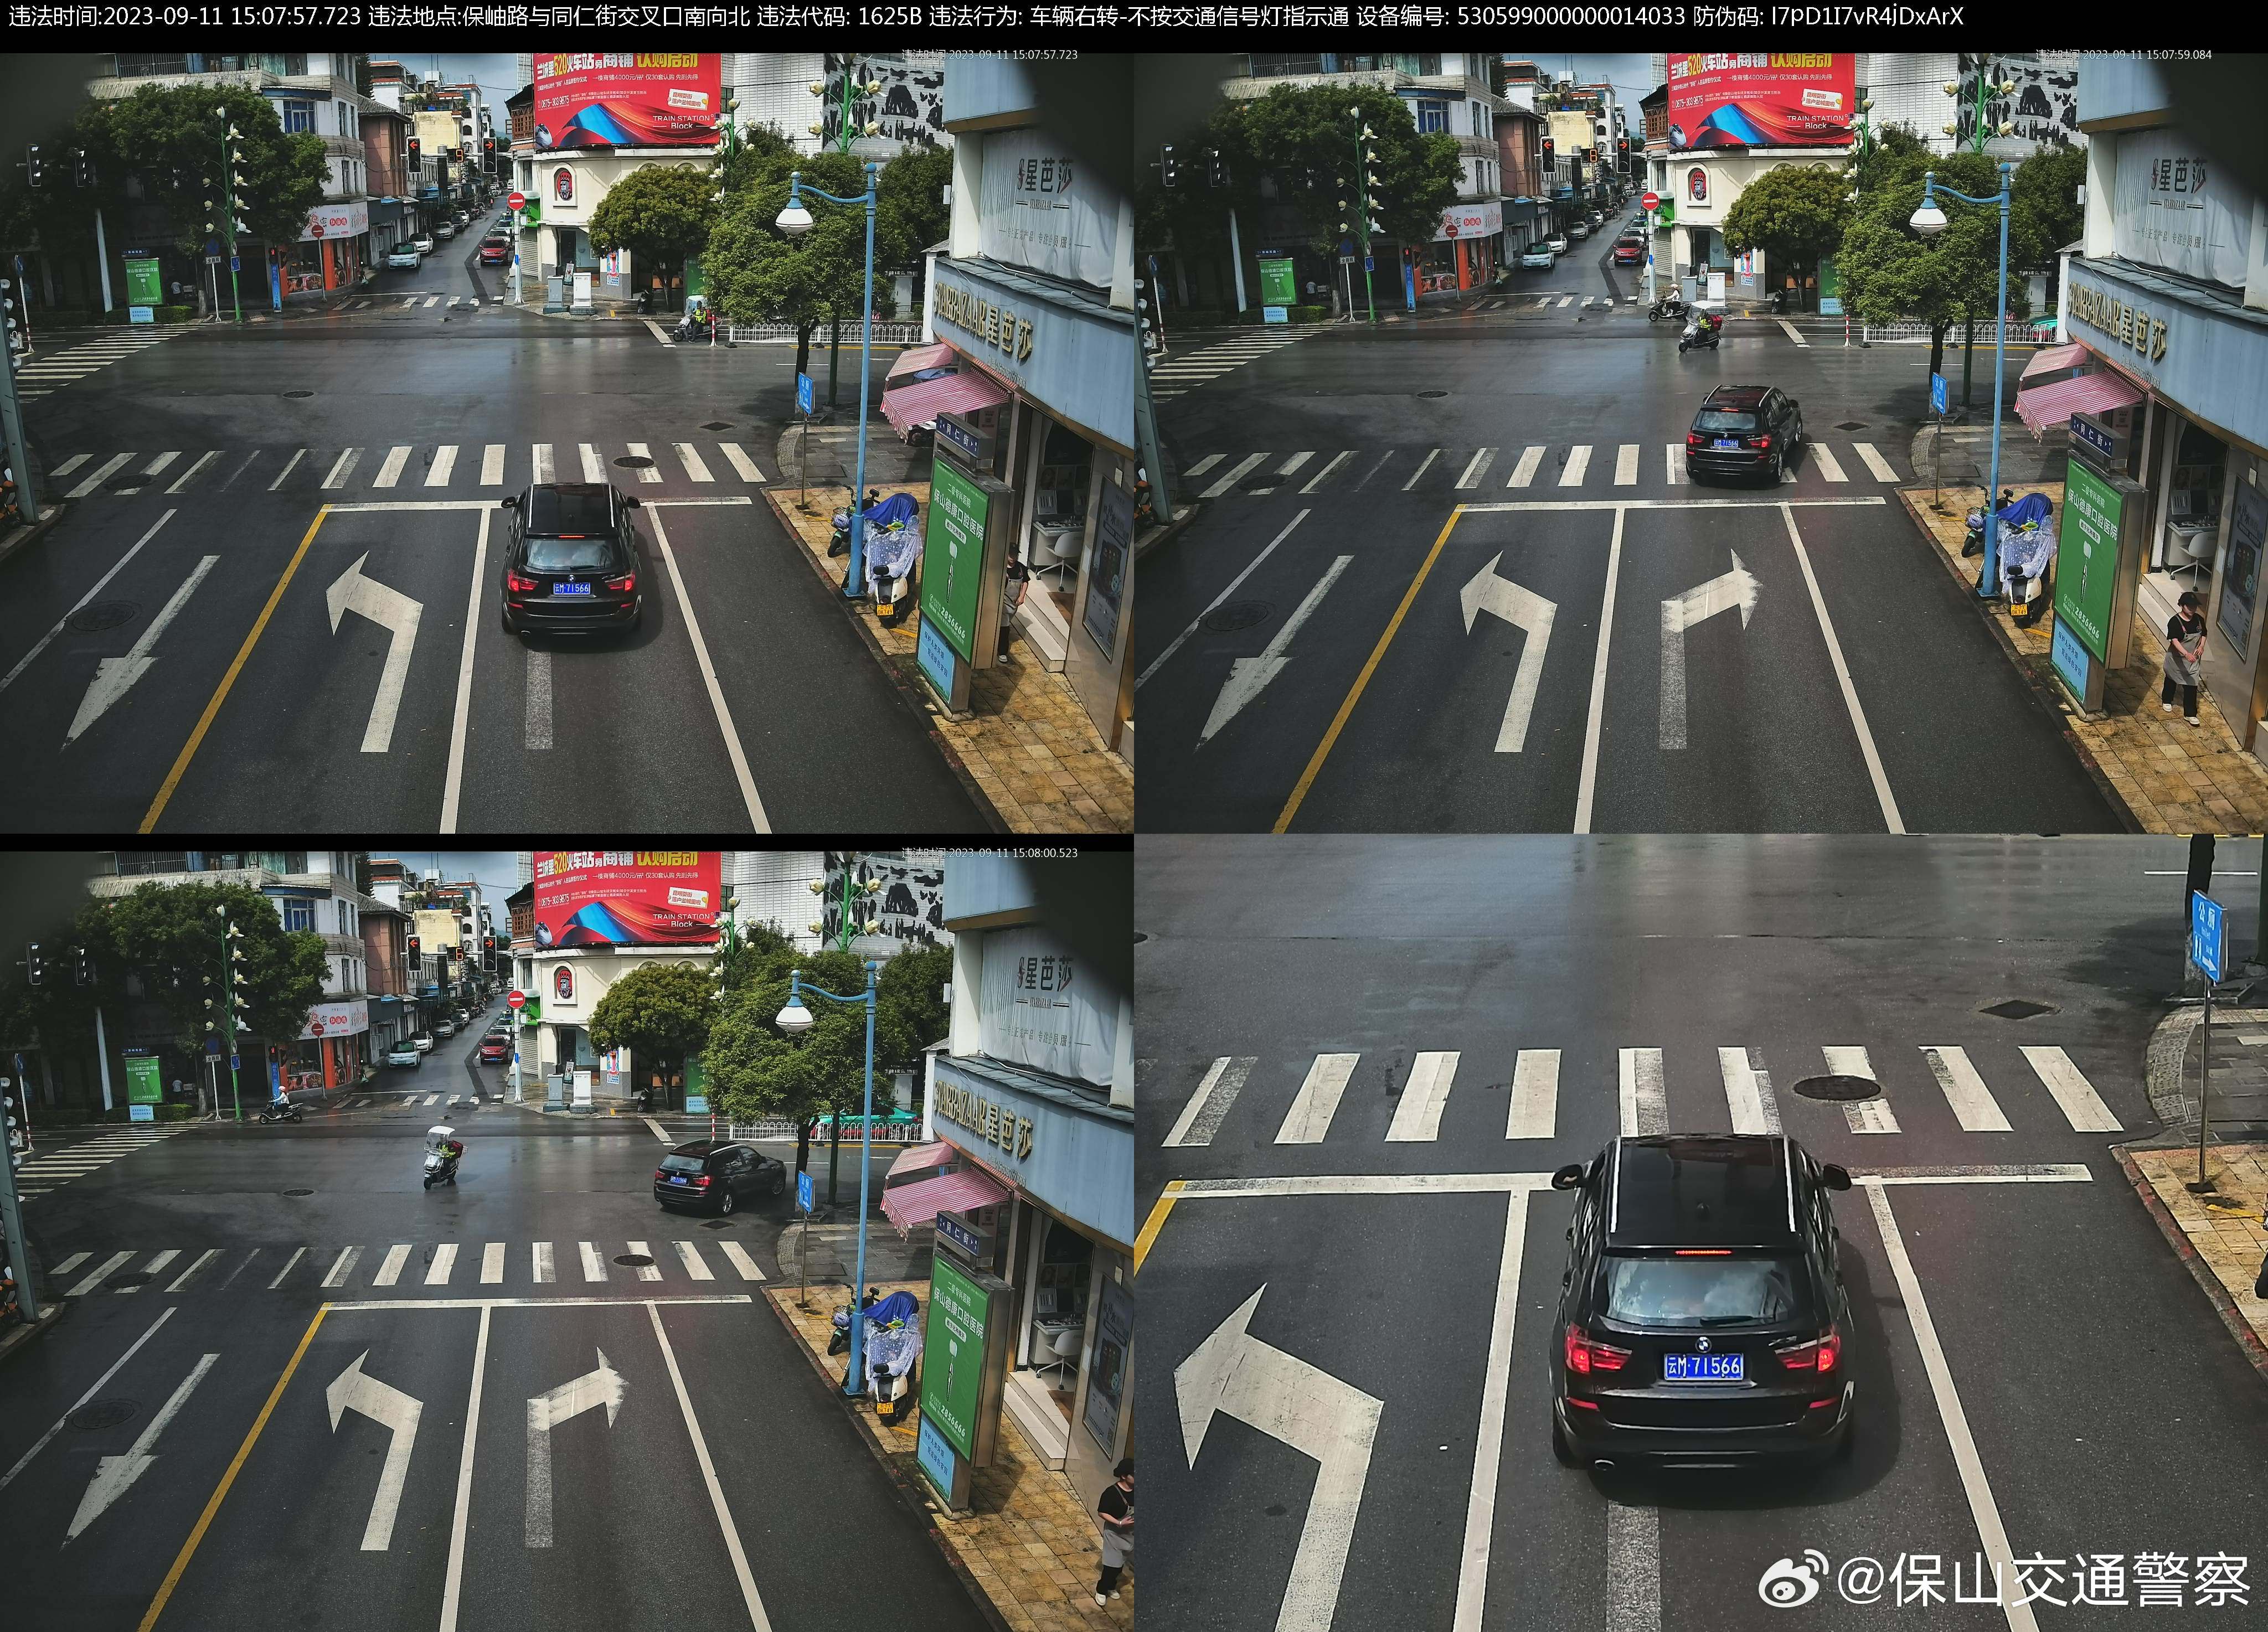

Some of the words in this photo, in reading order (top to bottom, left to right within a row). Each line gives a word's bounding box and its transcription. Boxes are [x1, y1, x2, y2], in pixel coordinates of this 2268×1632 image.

[1025, 157, 1073, 194] 星芭莎
[2159, 157, 2207, 194] 星芭莎
[1007, 226, 1034, 242] 专正宗产品
[2141, 226, 2168, 242] 专正宗产品
[934, 281, 987, 337] STARBAZAAR
[988, 304, 1033, 359] 星芭莎
[2068, 281, 2121, 337] STARBAZAAR
[2122, 304, 2167, 359] 星芭莎
[946, 423, 969, 447] 同仁街
[2080, 423, 2103, 447] 同仁街
[948, 483, 971, 508] 二级专科医院
[2082, 483, 2105, 508] 二级专科医院
[934, 488, 984, 541] 保山德康口腔医院
[2068, 488, 2118, 541] 保山德康口腔医院
[941, 607, 966, 639] 2856666
[2075, 607, 2100, 639] 2856666
[1025, 956, 1073, 992] 星芭莎
[1007, 1025, 1034, 1040] 专正宗产品
[934, 1079, 987, 1135] STARBAZAAR
[988, 1103, 1033, 1158] 星芭莎
[946, 1221, 969, 1245] 同仁街
[948, 1282, 971, 1306] 二级专科医院
[934, 1286, 984, 1339] 保山德康口腔医院
[941, 1405, 966, 1437] 2856666
